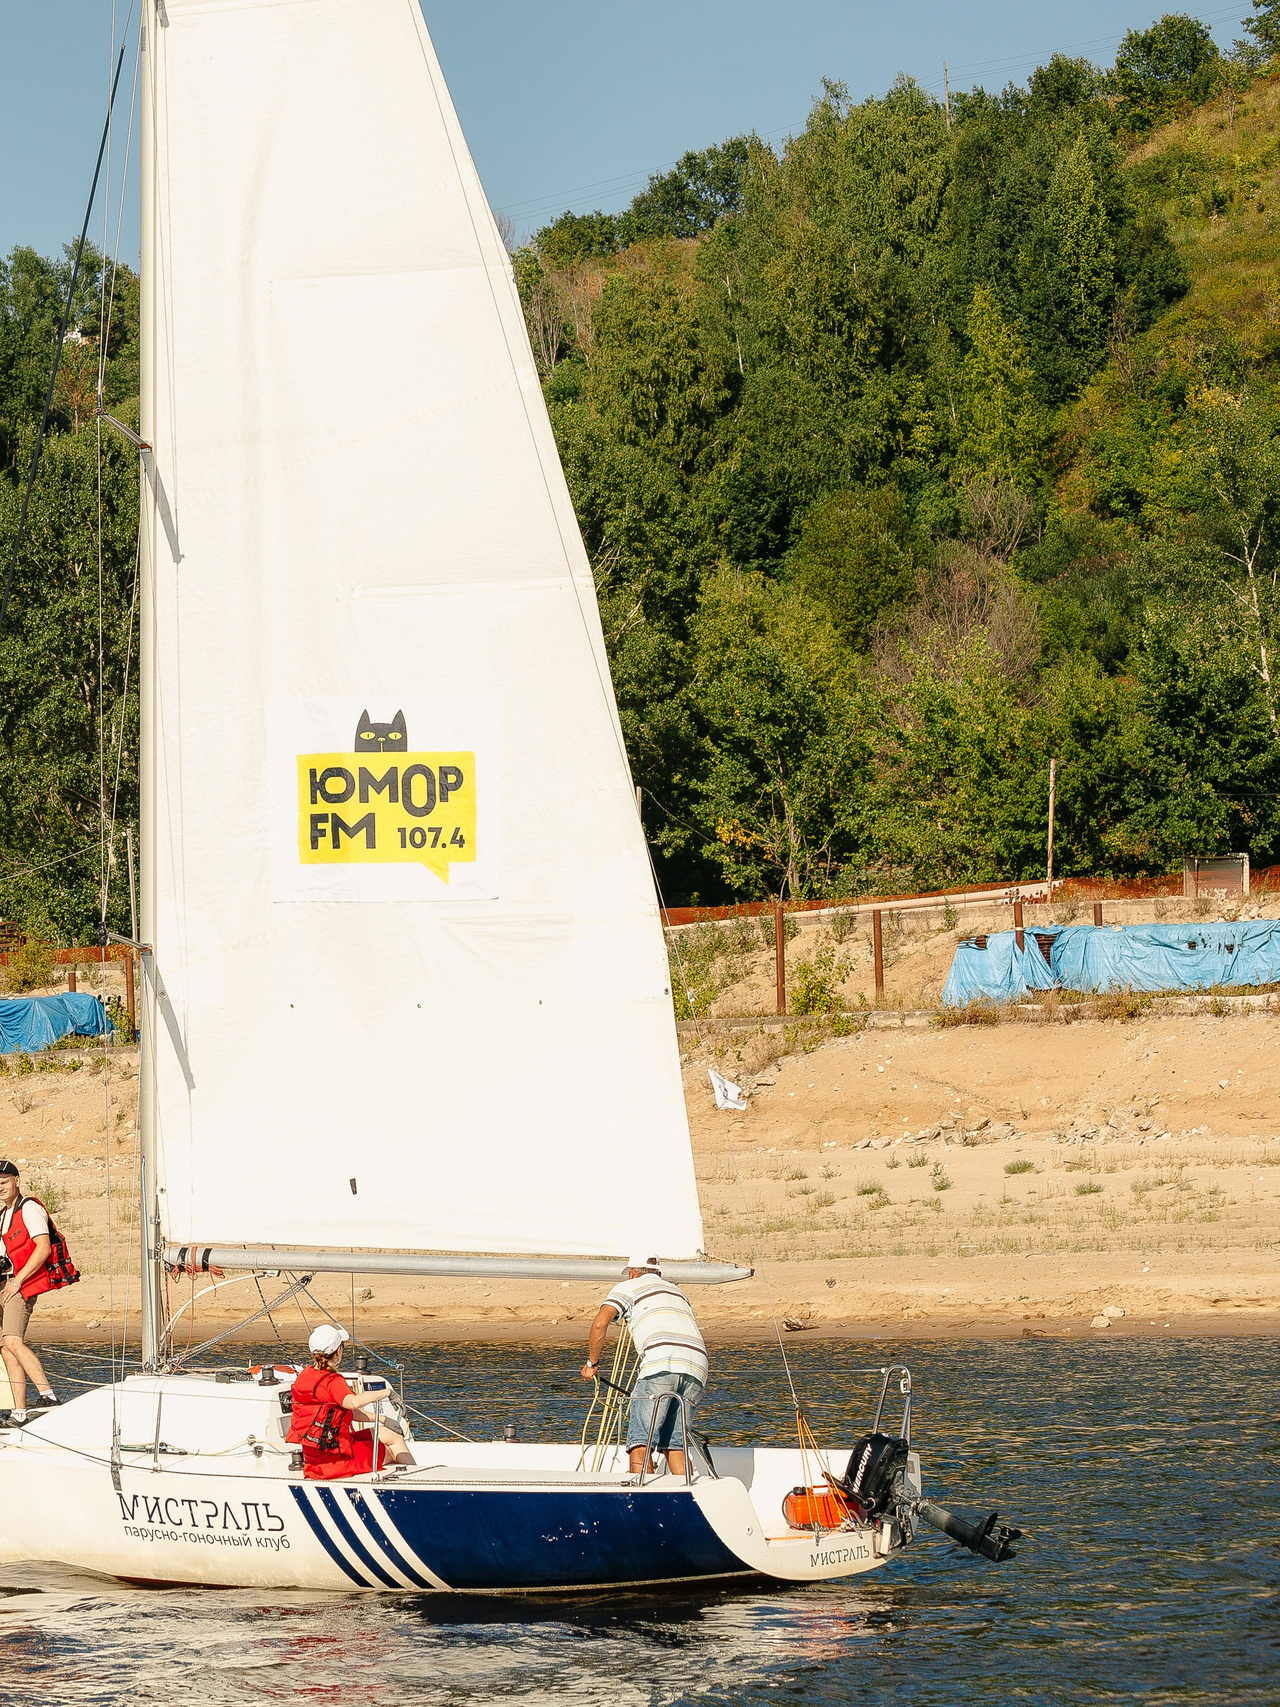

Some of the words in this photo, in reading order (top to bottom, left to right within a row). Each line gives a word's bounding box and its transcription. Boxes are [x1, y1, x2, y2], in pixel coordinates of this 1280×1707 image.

[309, 763, 464, 817] ЮМОР
[310, 812, 376, 849] FM
[397, 826, 465, 849] 107.4
[116, 1492, 285, 1532] МИСТРАЛЬ
[124, 1525, 253, 1548] парусно-гоночный
[255, 1534, 291, 1552] клуб
[810, 1545, 870, 1568] МИСТРАЛЬ
